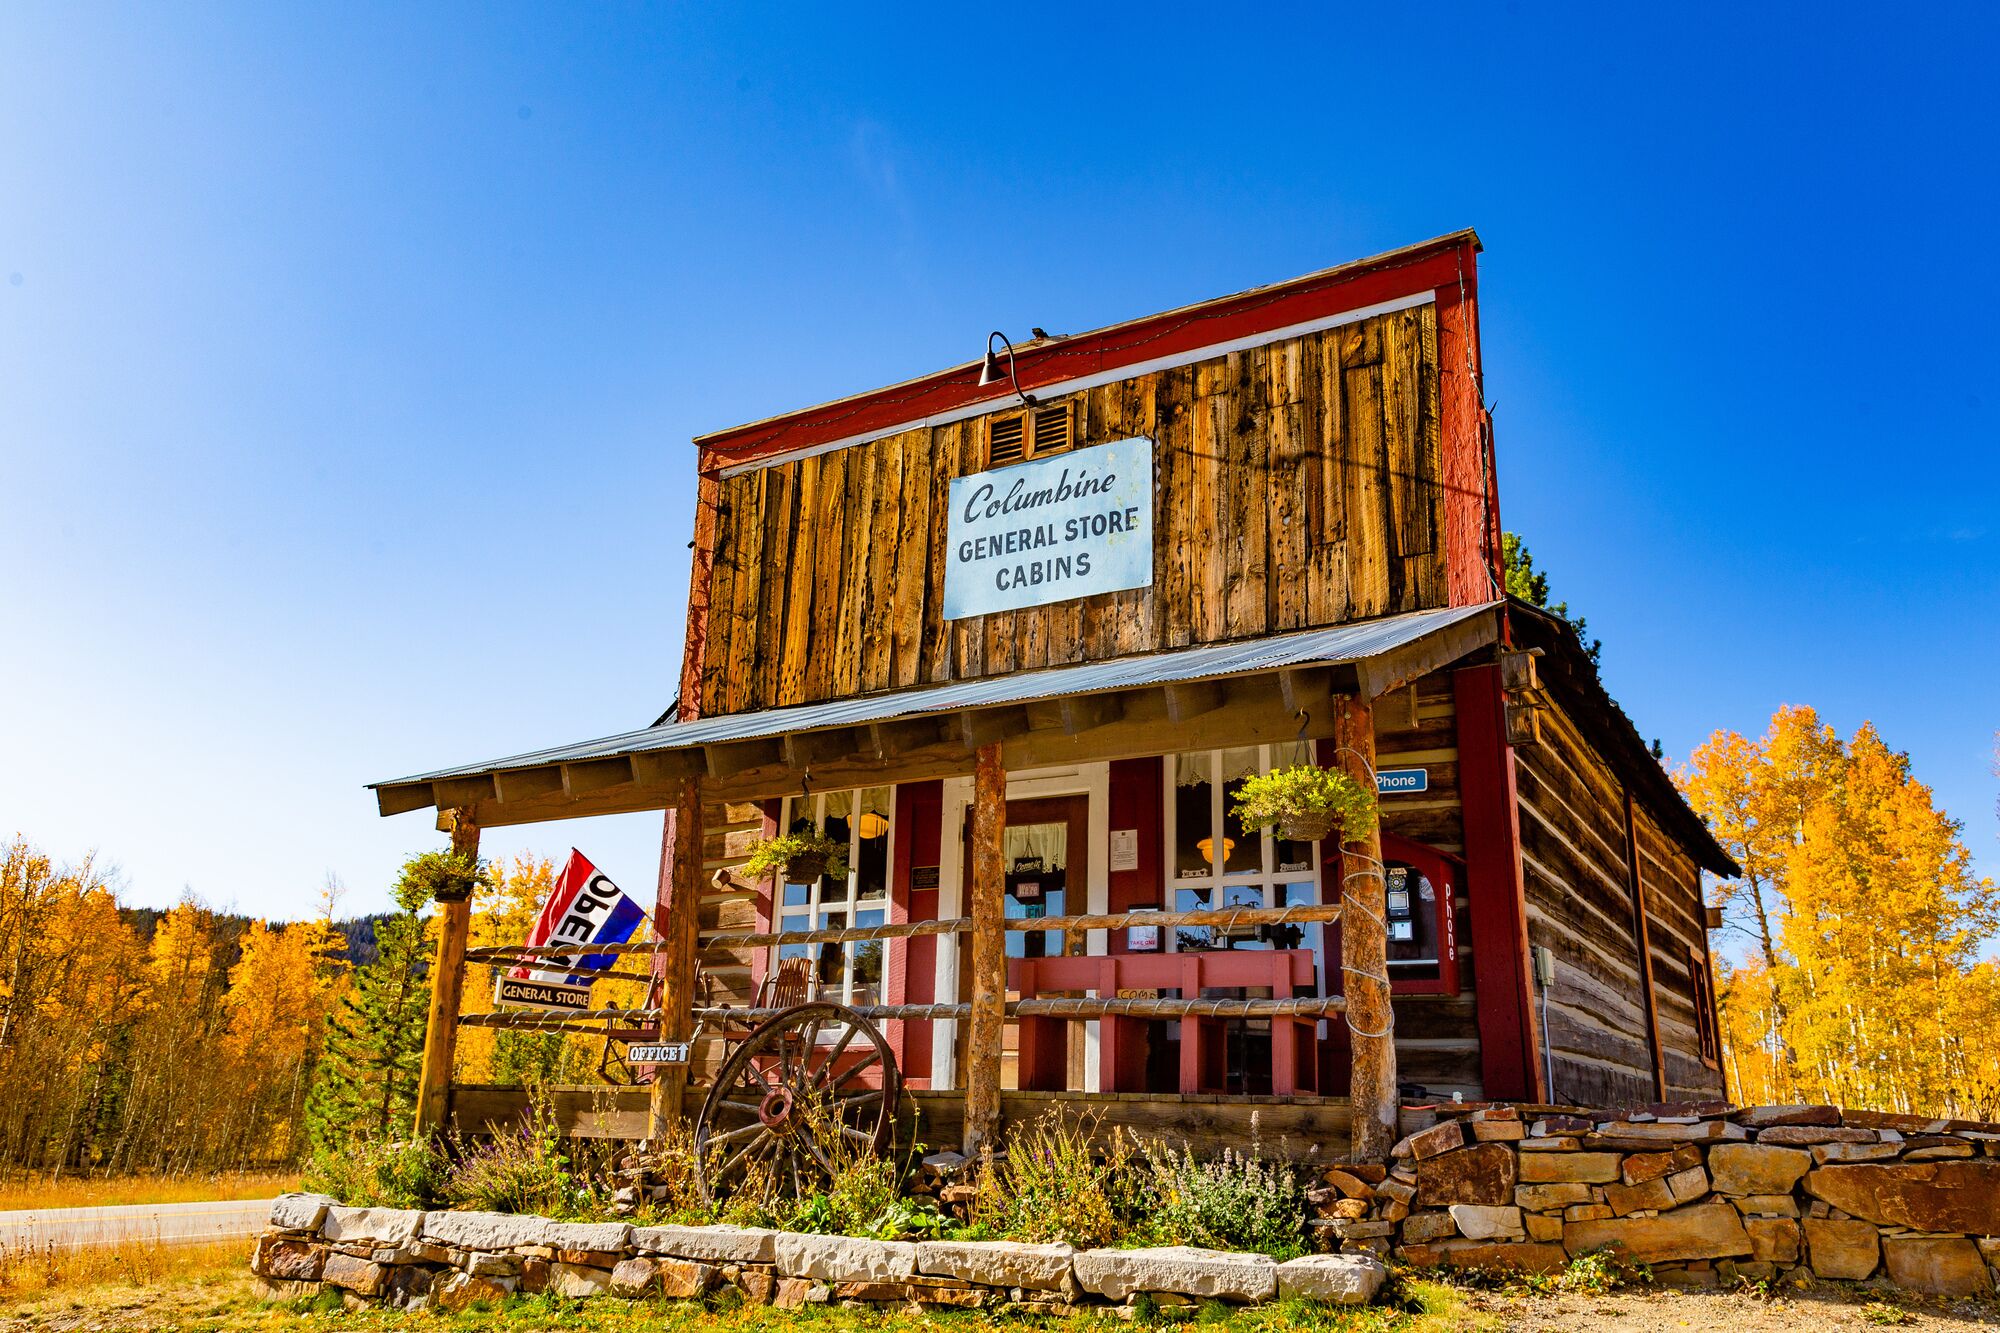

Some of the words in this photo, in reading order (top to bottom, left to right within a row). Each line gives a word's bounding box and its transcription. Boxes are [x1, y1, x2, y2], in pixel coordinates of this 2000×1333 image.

[963, 468, 1116, 523] Columbine
[958, 524, 1058, 563] GENERAL
[1064, 507, 1139, 542] STORE
[995, 553, 1091, 591] CABINS
[1377, 776, 1416, 787] Phone
[503, 985, 552, 1002] GENERAL
[556, 991, 589, 1006] STORE
[630, 1046, 678, 1061] OFFICE
